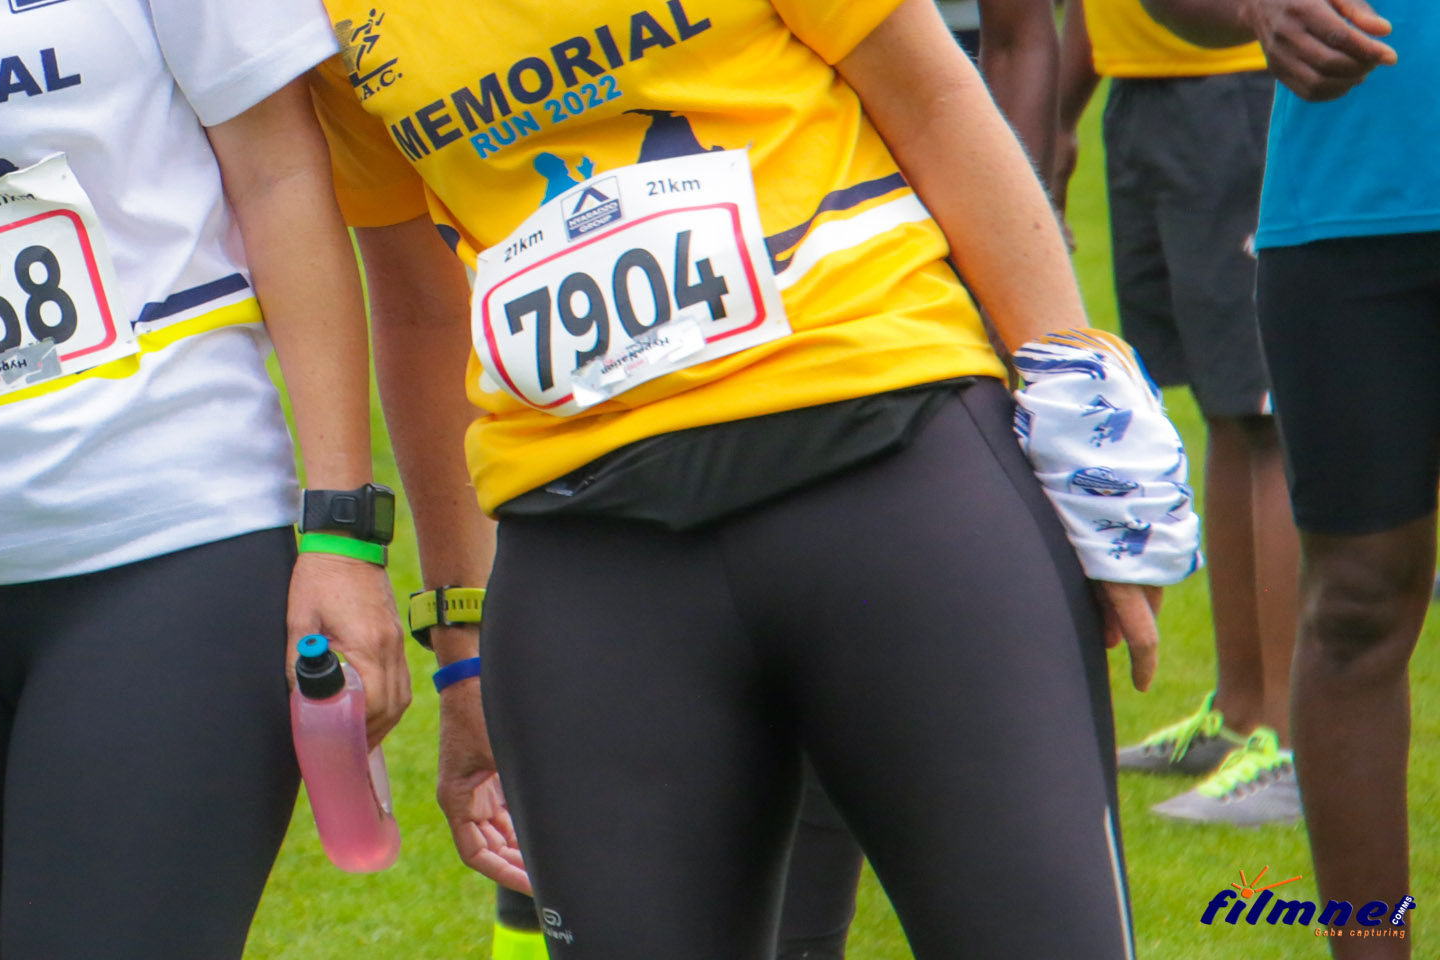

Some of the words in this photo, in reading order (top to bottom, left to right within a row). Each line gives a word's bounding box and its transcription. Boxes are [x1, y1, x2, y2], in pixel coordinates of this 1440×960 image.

[470, 111, 541, 160] RUN
[543, 75, 624, 124] 2022
[646, 177, 701, 197] 21km
[504, 230, 544, 262] 21km
[504, 229, 729, 392] 7904
